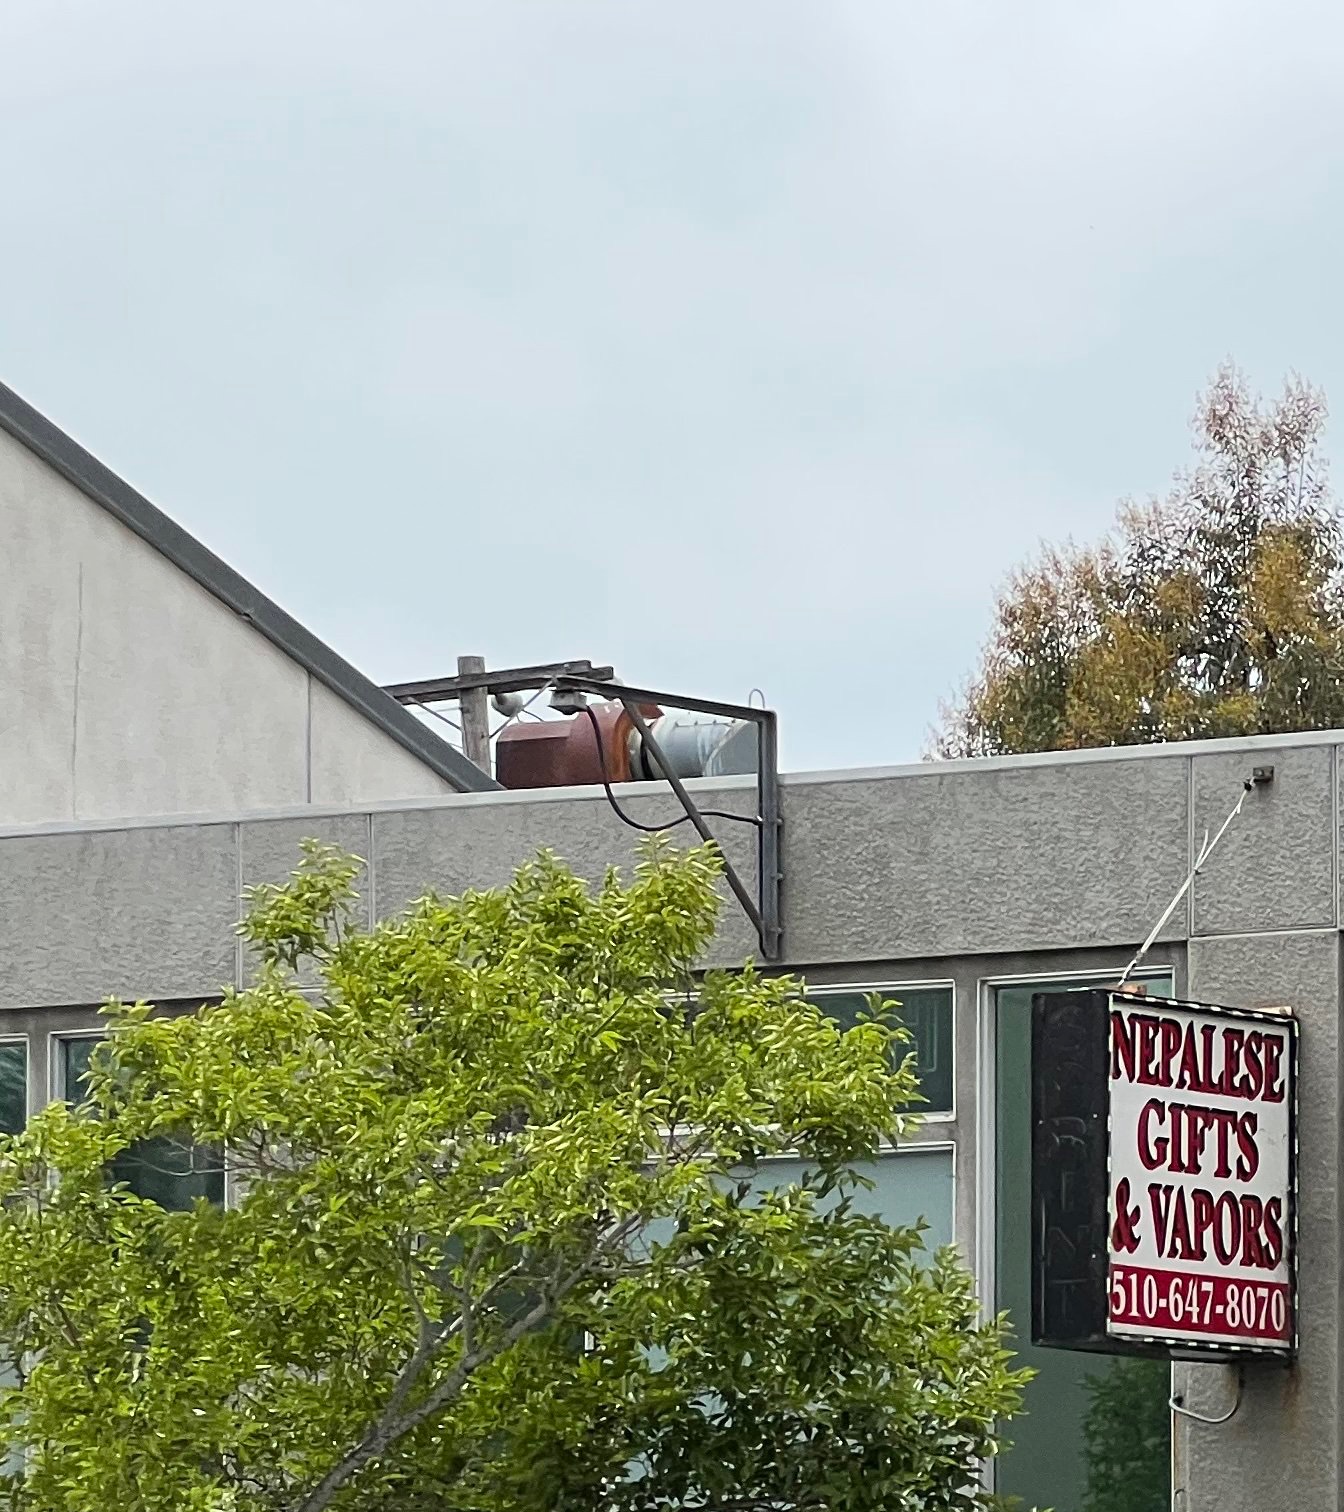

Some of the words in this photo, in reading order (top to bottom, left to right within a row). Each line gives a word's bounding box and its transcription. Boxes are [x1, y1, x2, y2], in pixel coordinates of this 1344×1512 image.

[1111, 1010, 1285, 1103] NEPALESE
[1138, 1098, 1259, 1182] GIFTS
[1112, 1177, 1141, 1254] &
[1148, 1183, 1282, 1271] VAPORS
[1111, 1271, 1285, 1331] 510-647-8070
